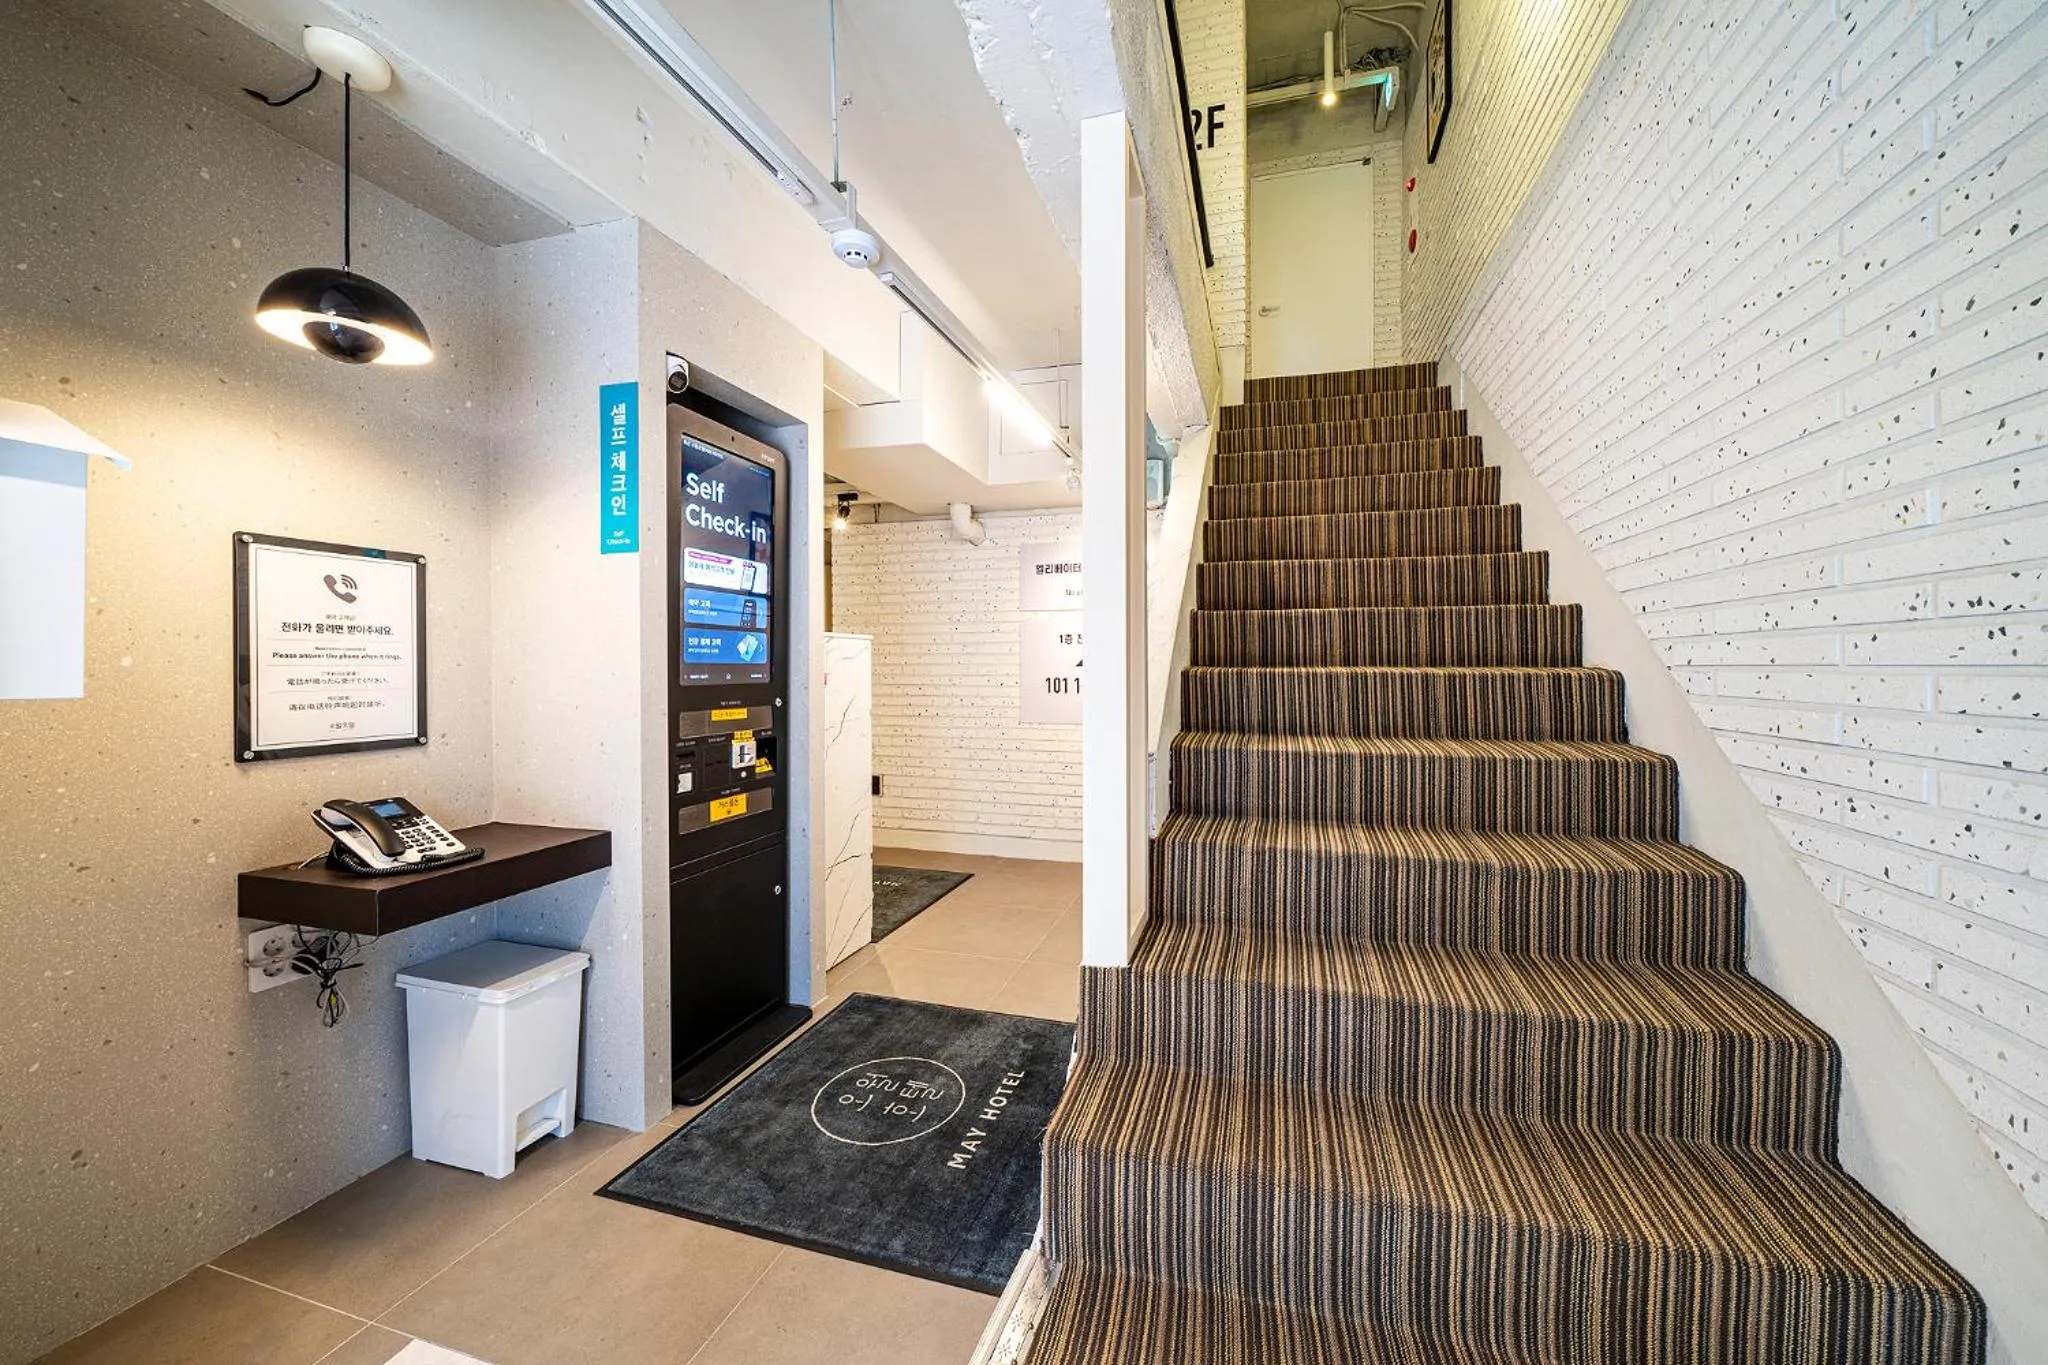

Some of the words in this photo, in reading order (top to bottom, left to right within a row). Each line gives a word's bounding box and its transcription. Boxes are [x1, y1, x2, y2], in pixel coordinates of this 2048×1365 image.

[1190, 104, 1225, 150] 2F
[686, 472, 725, 504] Self
[685, 503, 767, 544] Check-in
[281, 621, 312, 633] 전화가
[272, 651, 297, 659] Please
[1045, 677, 1068, 694] 101
[947, 1127, 987, 1170] MAY
[979, 1070, 1025, 1121] HOTEL
